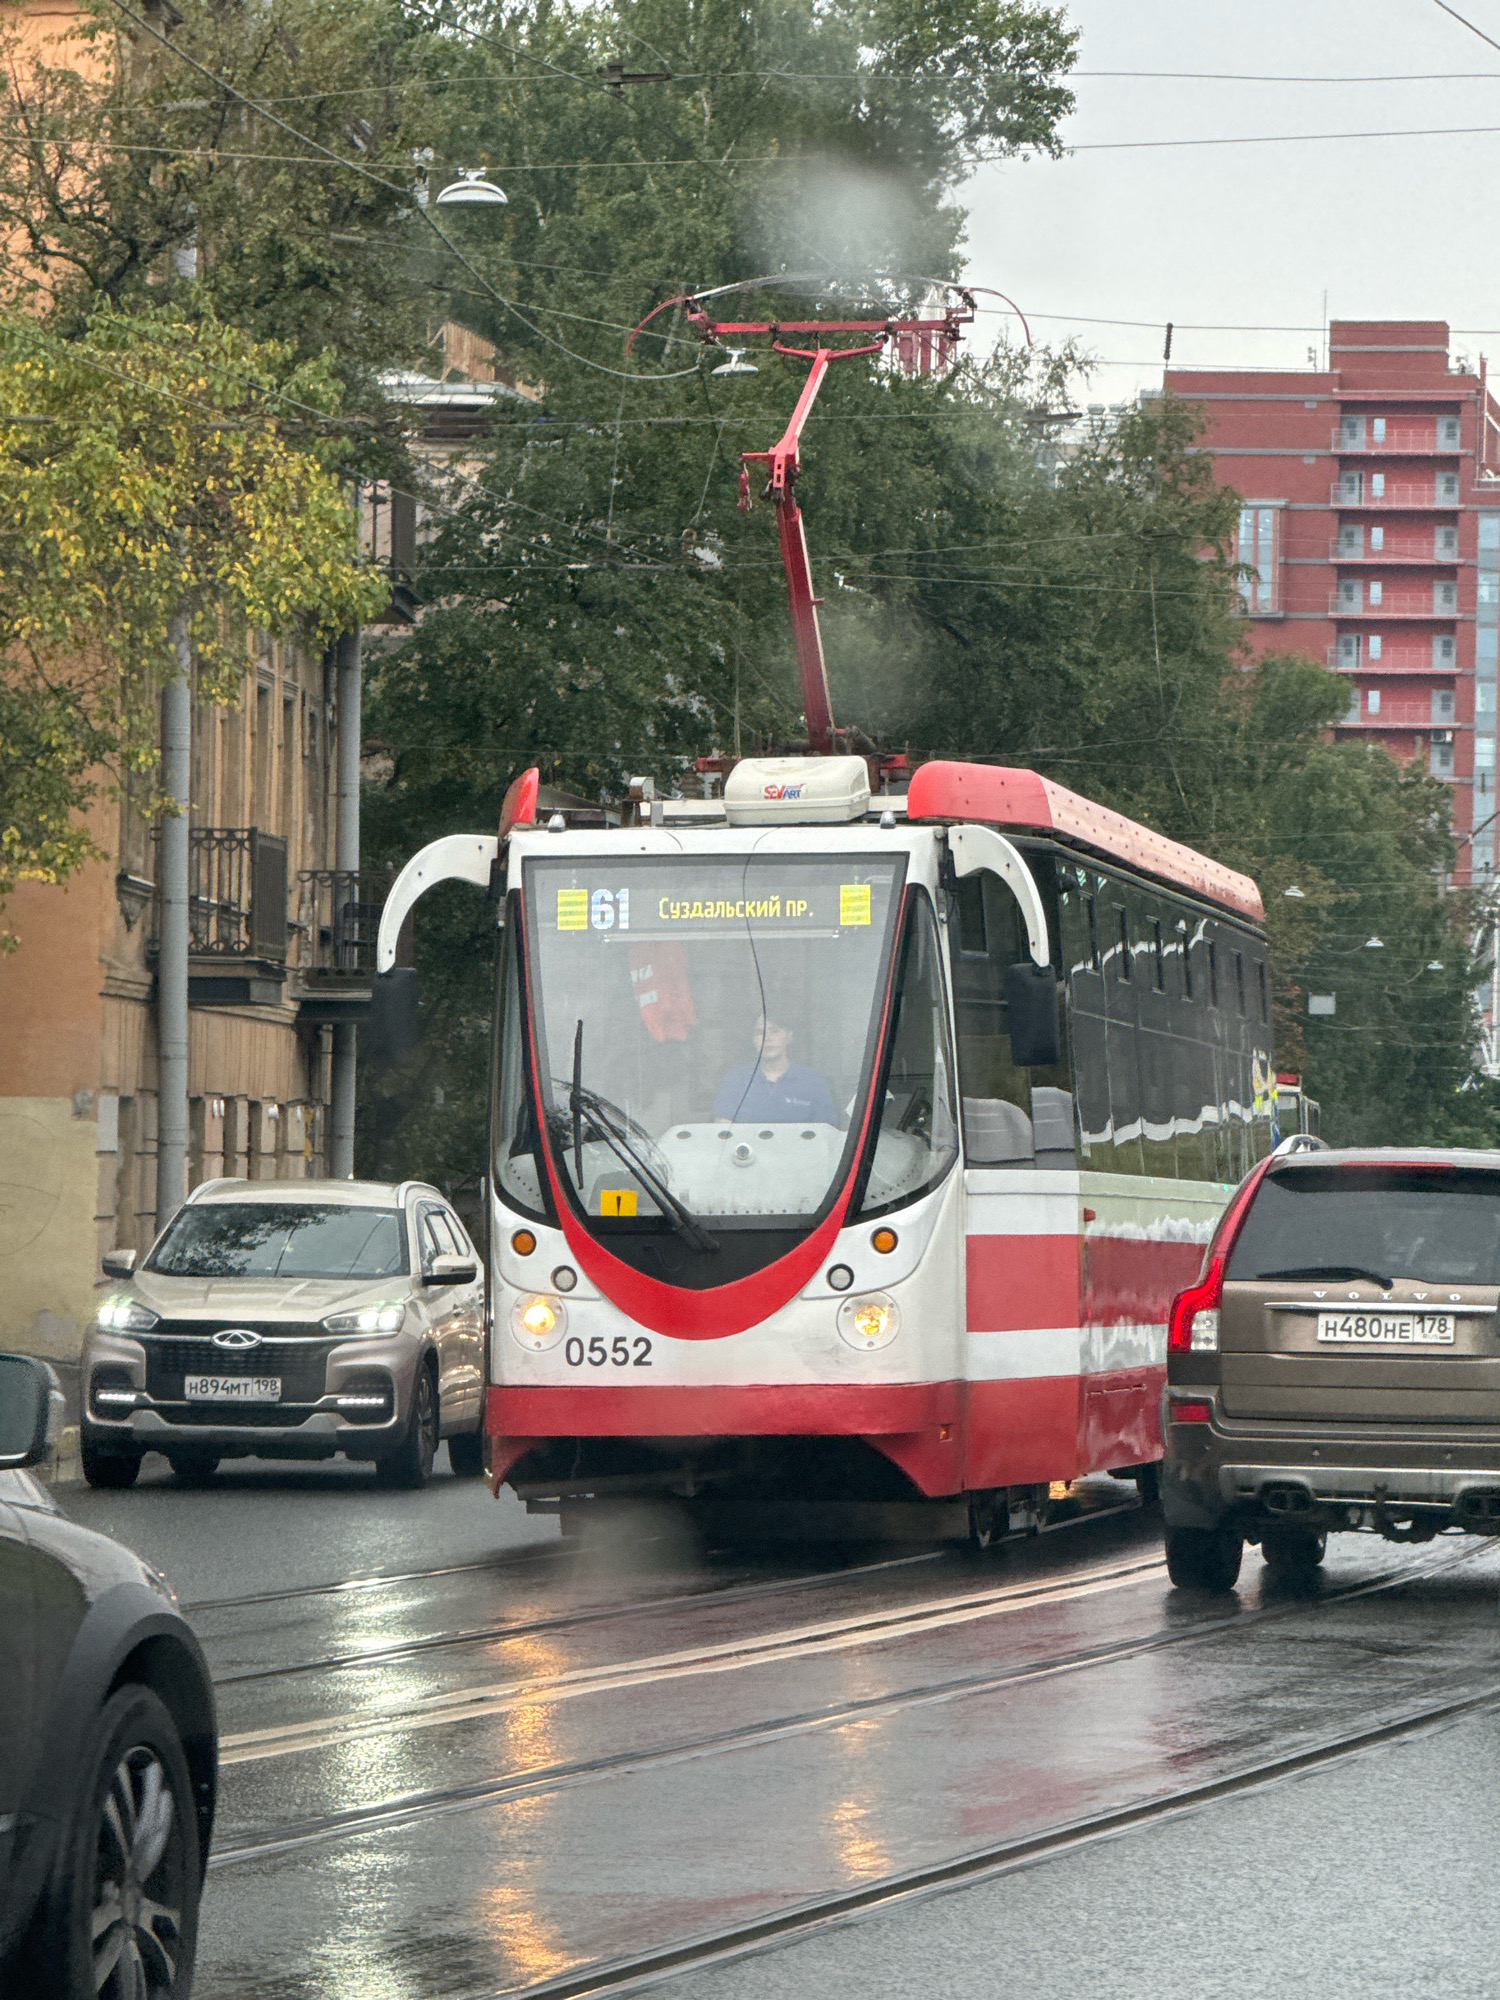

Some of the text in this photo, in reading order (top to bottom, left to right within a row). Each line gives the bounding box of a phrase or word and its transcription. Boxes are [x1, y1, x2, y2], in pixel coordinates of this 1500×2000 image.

[591, 888, 629, 929] 61
[659, 895, 781, 919] Суздальский
[786, 900, 814, 917] пр.
[1313, 1291, 1462, 1301] VOLVO
[1416, 1315, 1448, 1334] 178
[565, 1336, 653, 1367] 0552
[254, 1379, 278, 1391] 198
